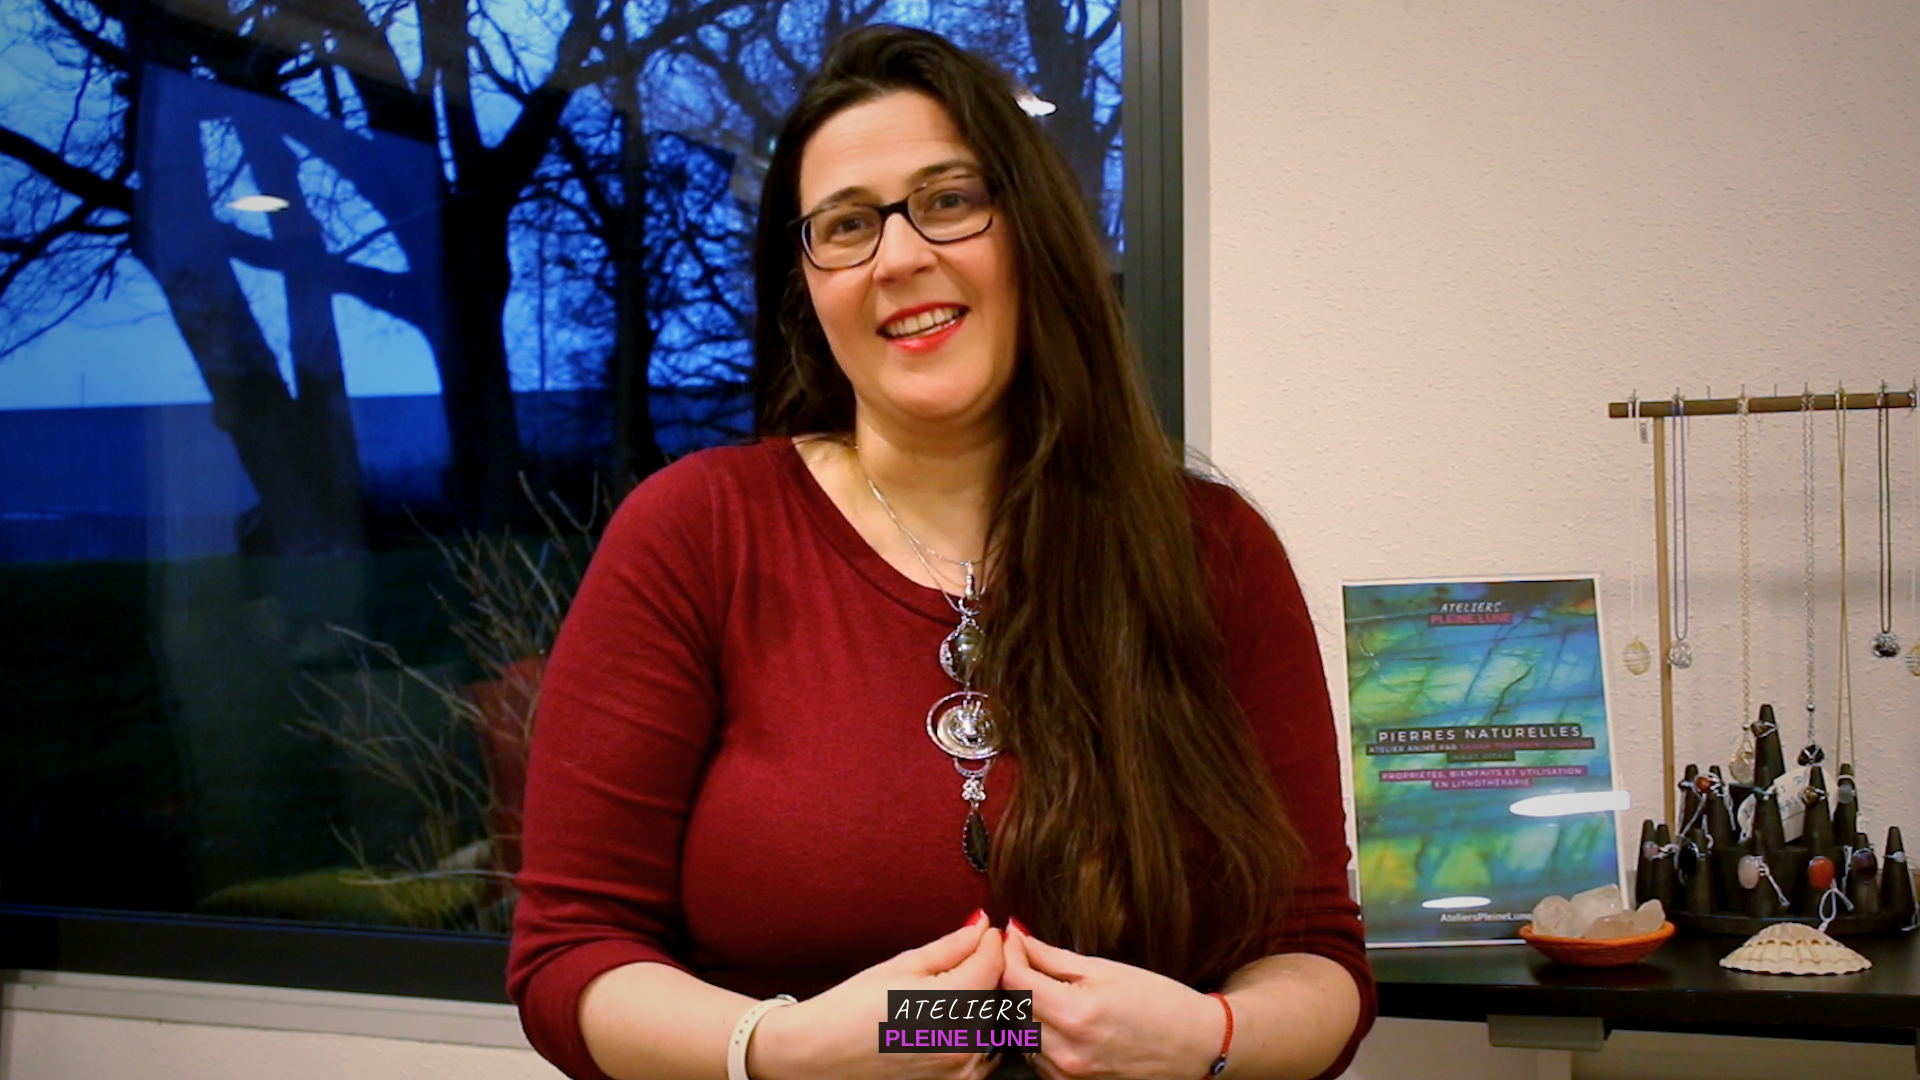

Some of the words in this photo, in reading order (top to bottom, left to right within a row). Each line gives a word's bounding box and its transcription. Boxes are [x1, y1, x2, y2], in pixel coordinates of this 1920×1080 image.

[1440, 601, 1502, 613] ATELIERS
[1430, 614, 1476, 624] PLEINE
[1478, 613, 1513, 623] LUNE
[1378, 729, 1456, 742] PIERRES
[1465, 726, 1581, 739] NATURELLES
[1368, 745, 1405, 753] ATELIER
[1438, 743, 1458, 751] PAR
[1449, 768, 1502, 778] BIENFAITS
[1520, 767, 1582, 776] UTILISATION
